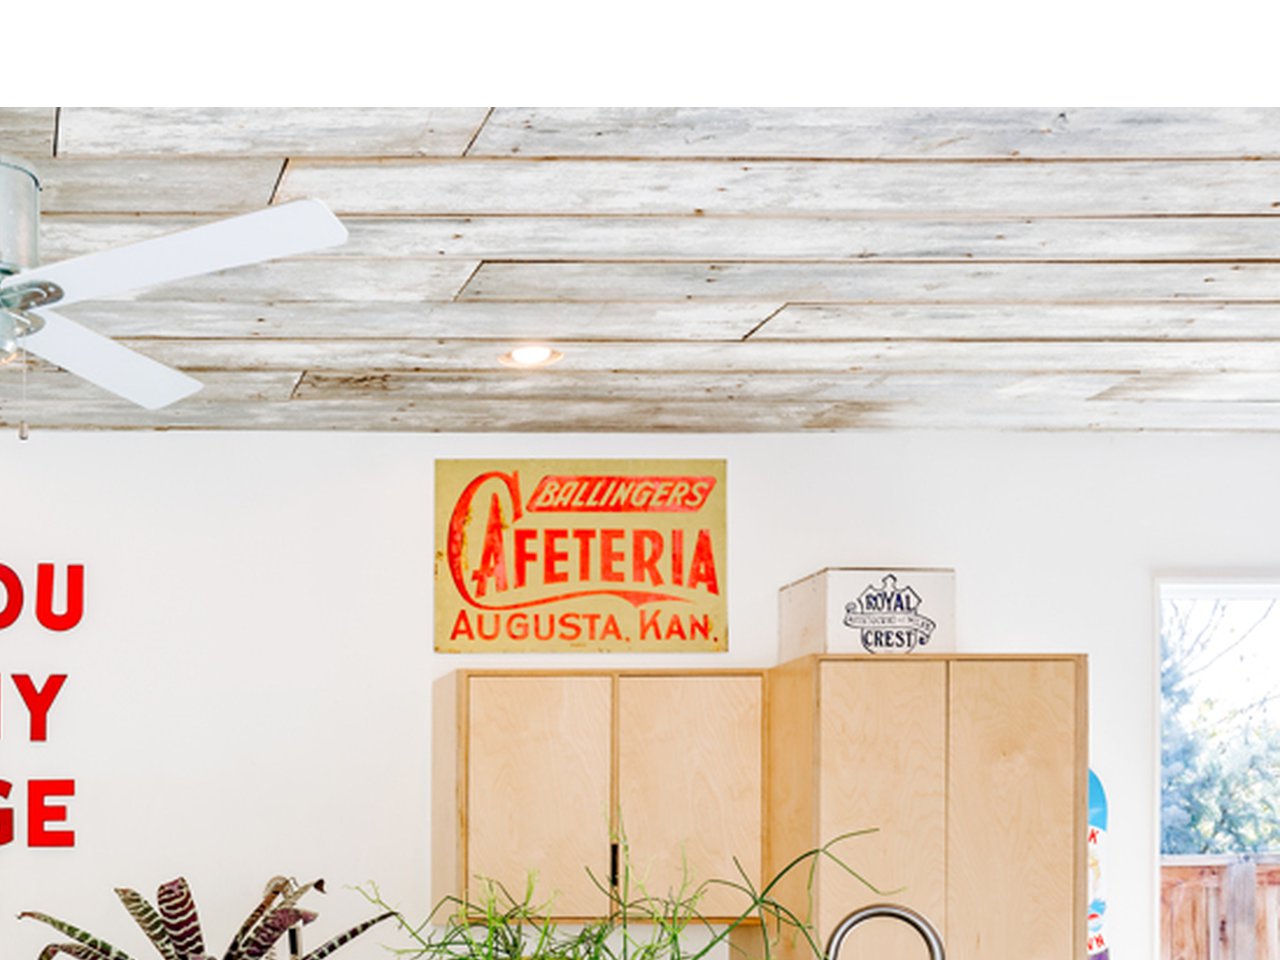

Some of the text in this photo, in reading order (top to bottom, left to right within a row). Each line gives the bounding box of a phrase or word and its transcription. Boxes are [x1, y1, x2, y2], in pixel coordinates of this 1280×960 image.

[536, 480, 709, 508] BALLINGERS
[447, 470, 720, 610] CAFETERIA
[864, 590, 917, 612] ROYAL
[863, 629, 915, 648] CREST
